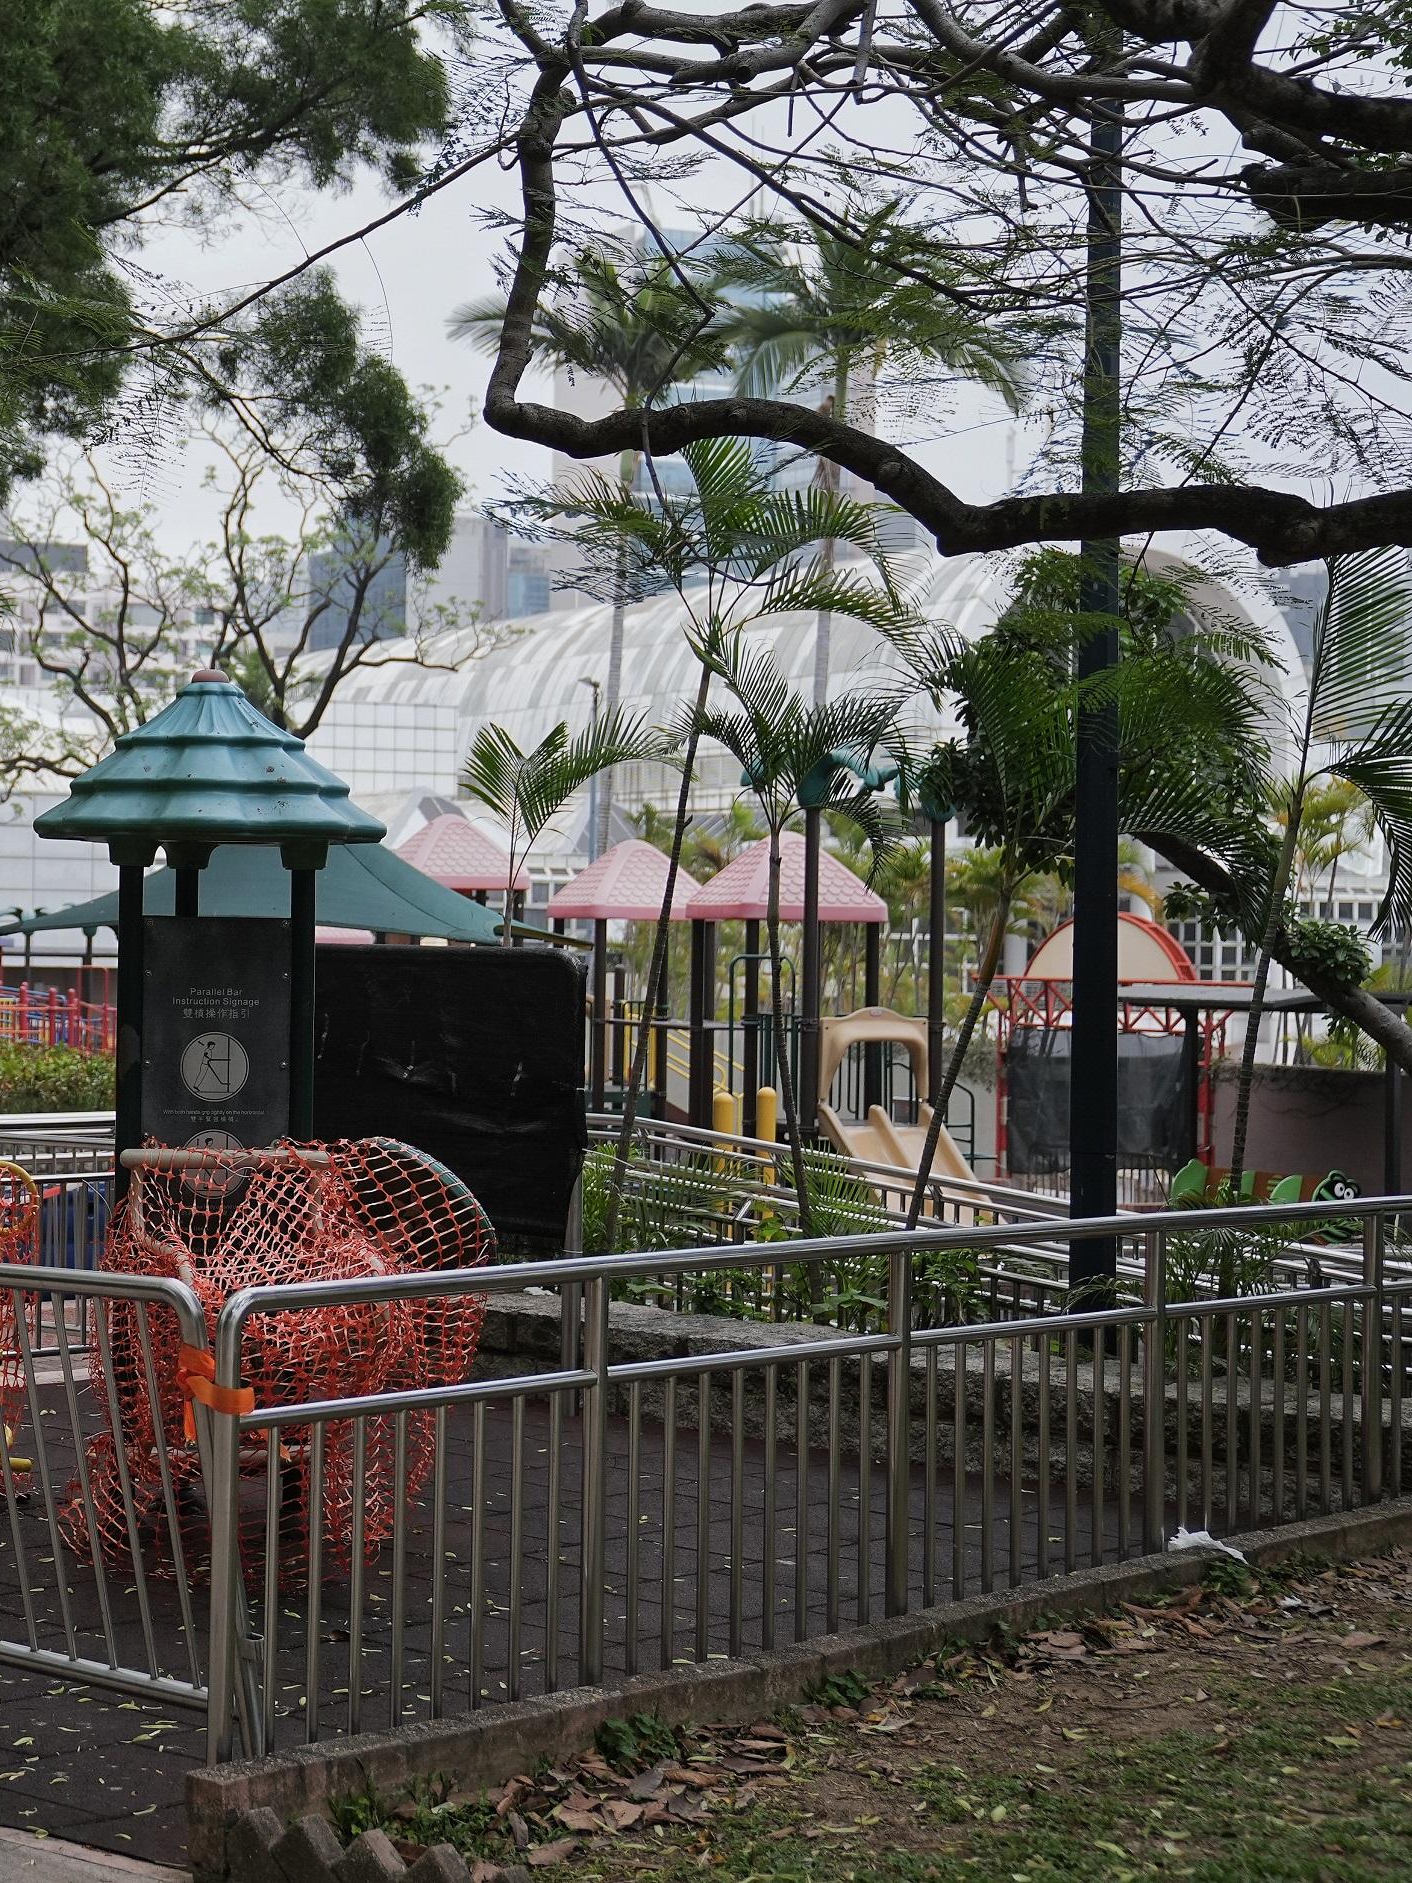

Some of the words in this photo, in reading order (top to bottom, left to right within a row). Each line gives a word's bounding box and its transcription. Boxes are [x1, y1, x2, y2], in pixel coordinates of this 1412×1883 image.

[190, 987, 225, 996] Parallel
[227, 987, 243, 996] Bar
[172, 997, 221, 1005] Instruction
[222, 997, 260, 1007] Signage
